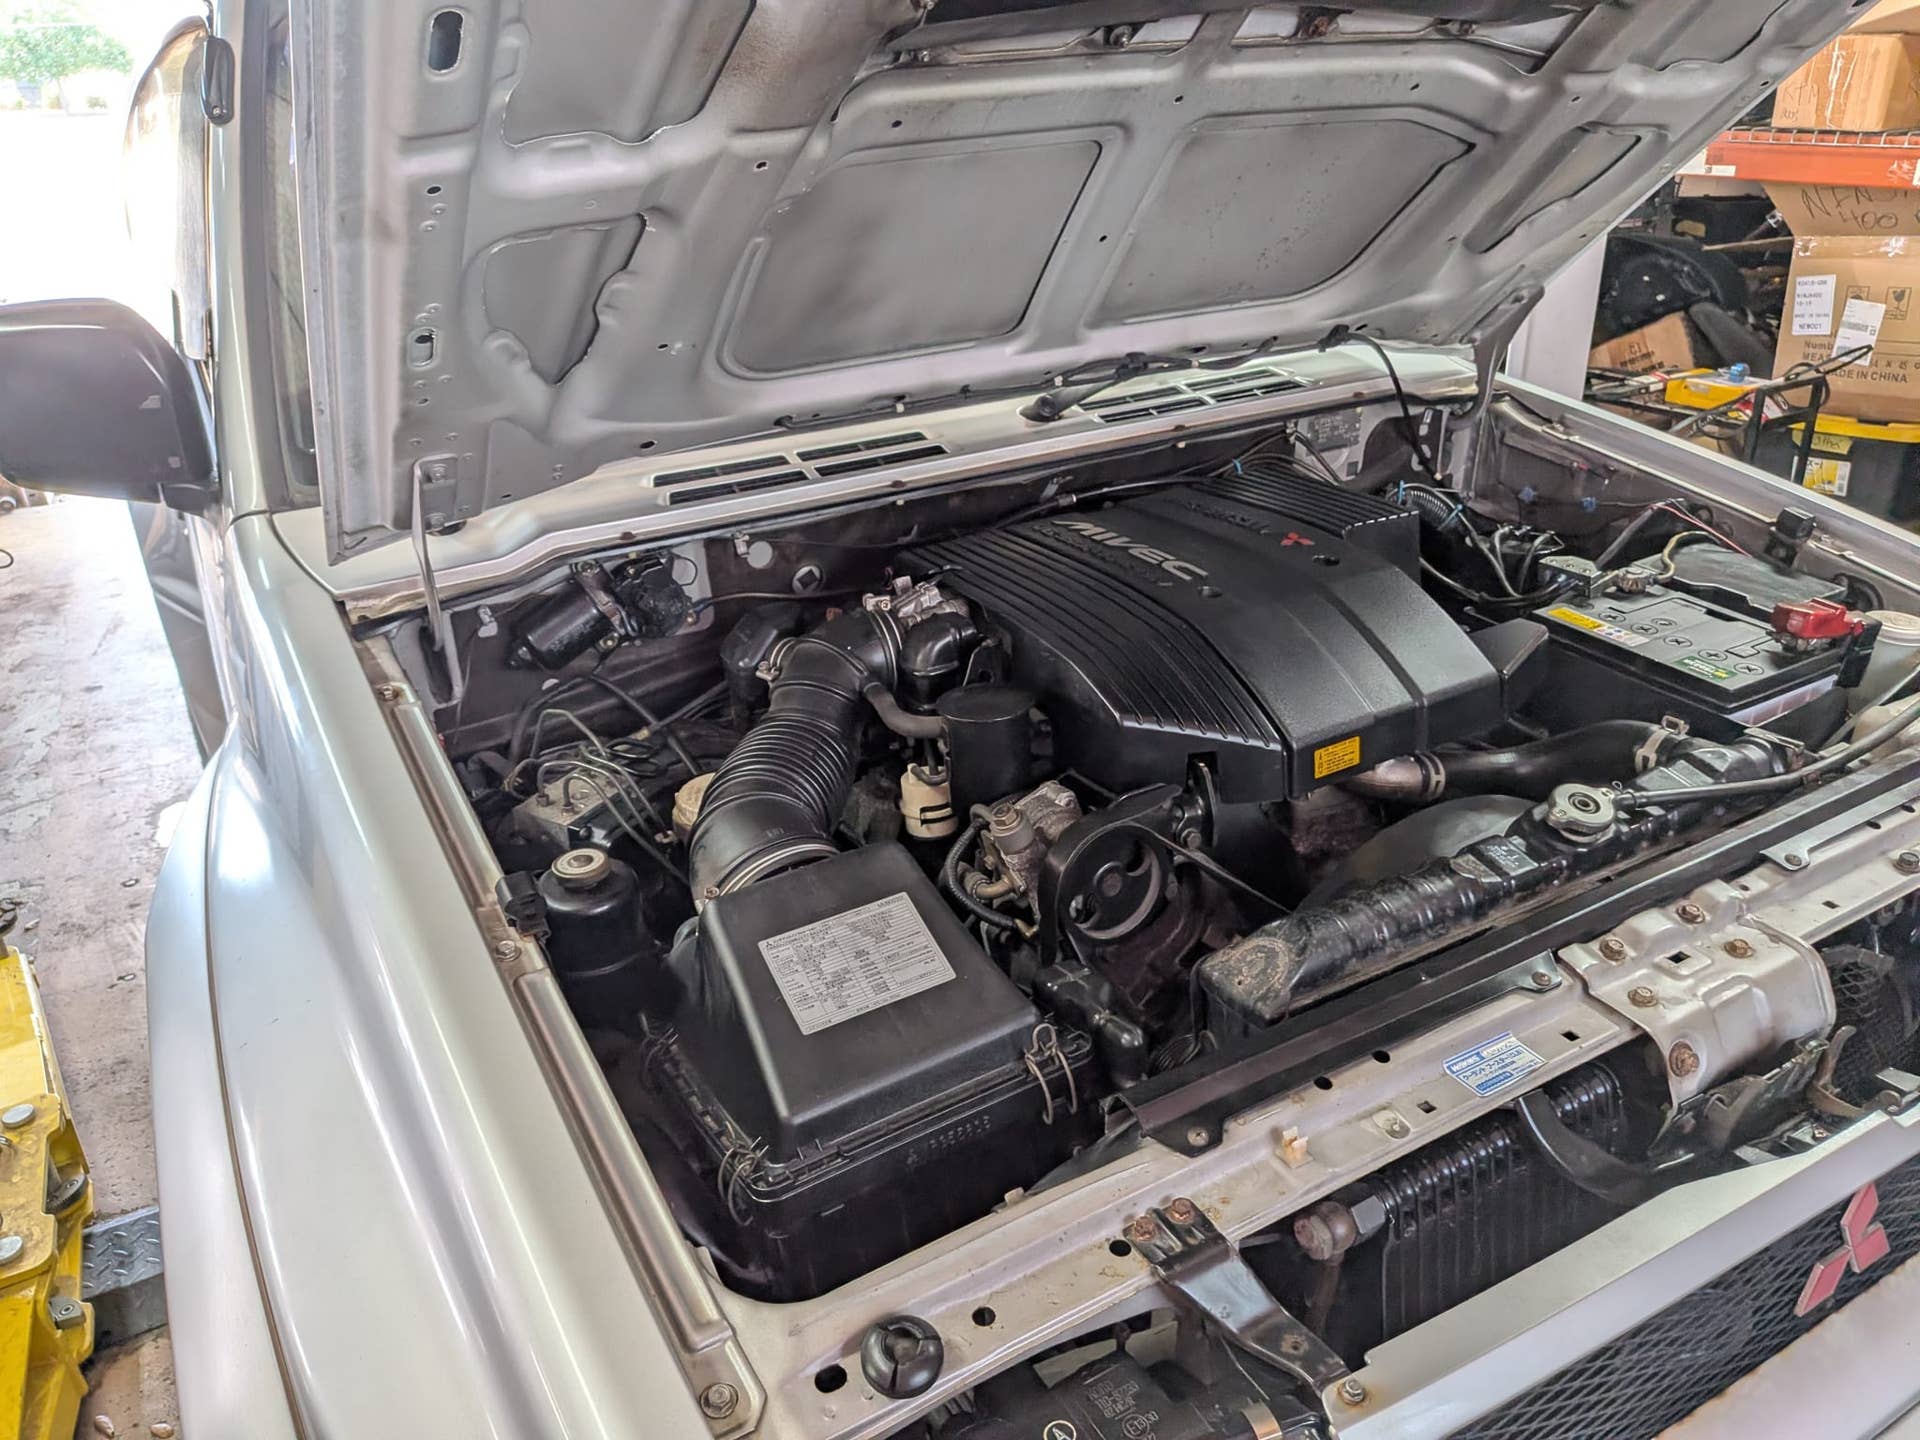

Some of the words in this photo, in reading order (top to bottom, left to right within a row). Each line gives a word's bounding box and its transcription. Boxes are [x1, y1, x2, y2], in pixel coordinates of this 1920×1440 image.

[1804, 340, 1833, 350] Numb
[1870, 371, 1909, 384] CHINA
[1050, 519, 1209, 581] MIVEC
